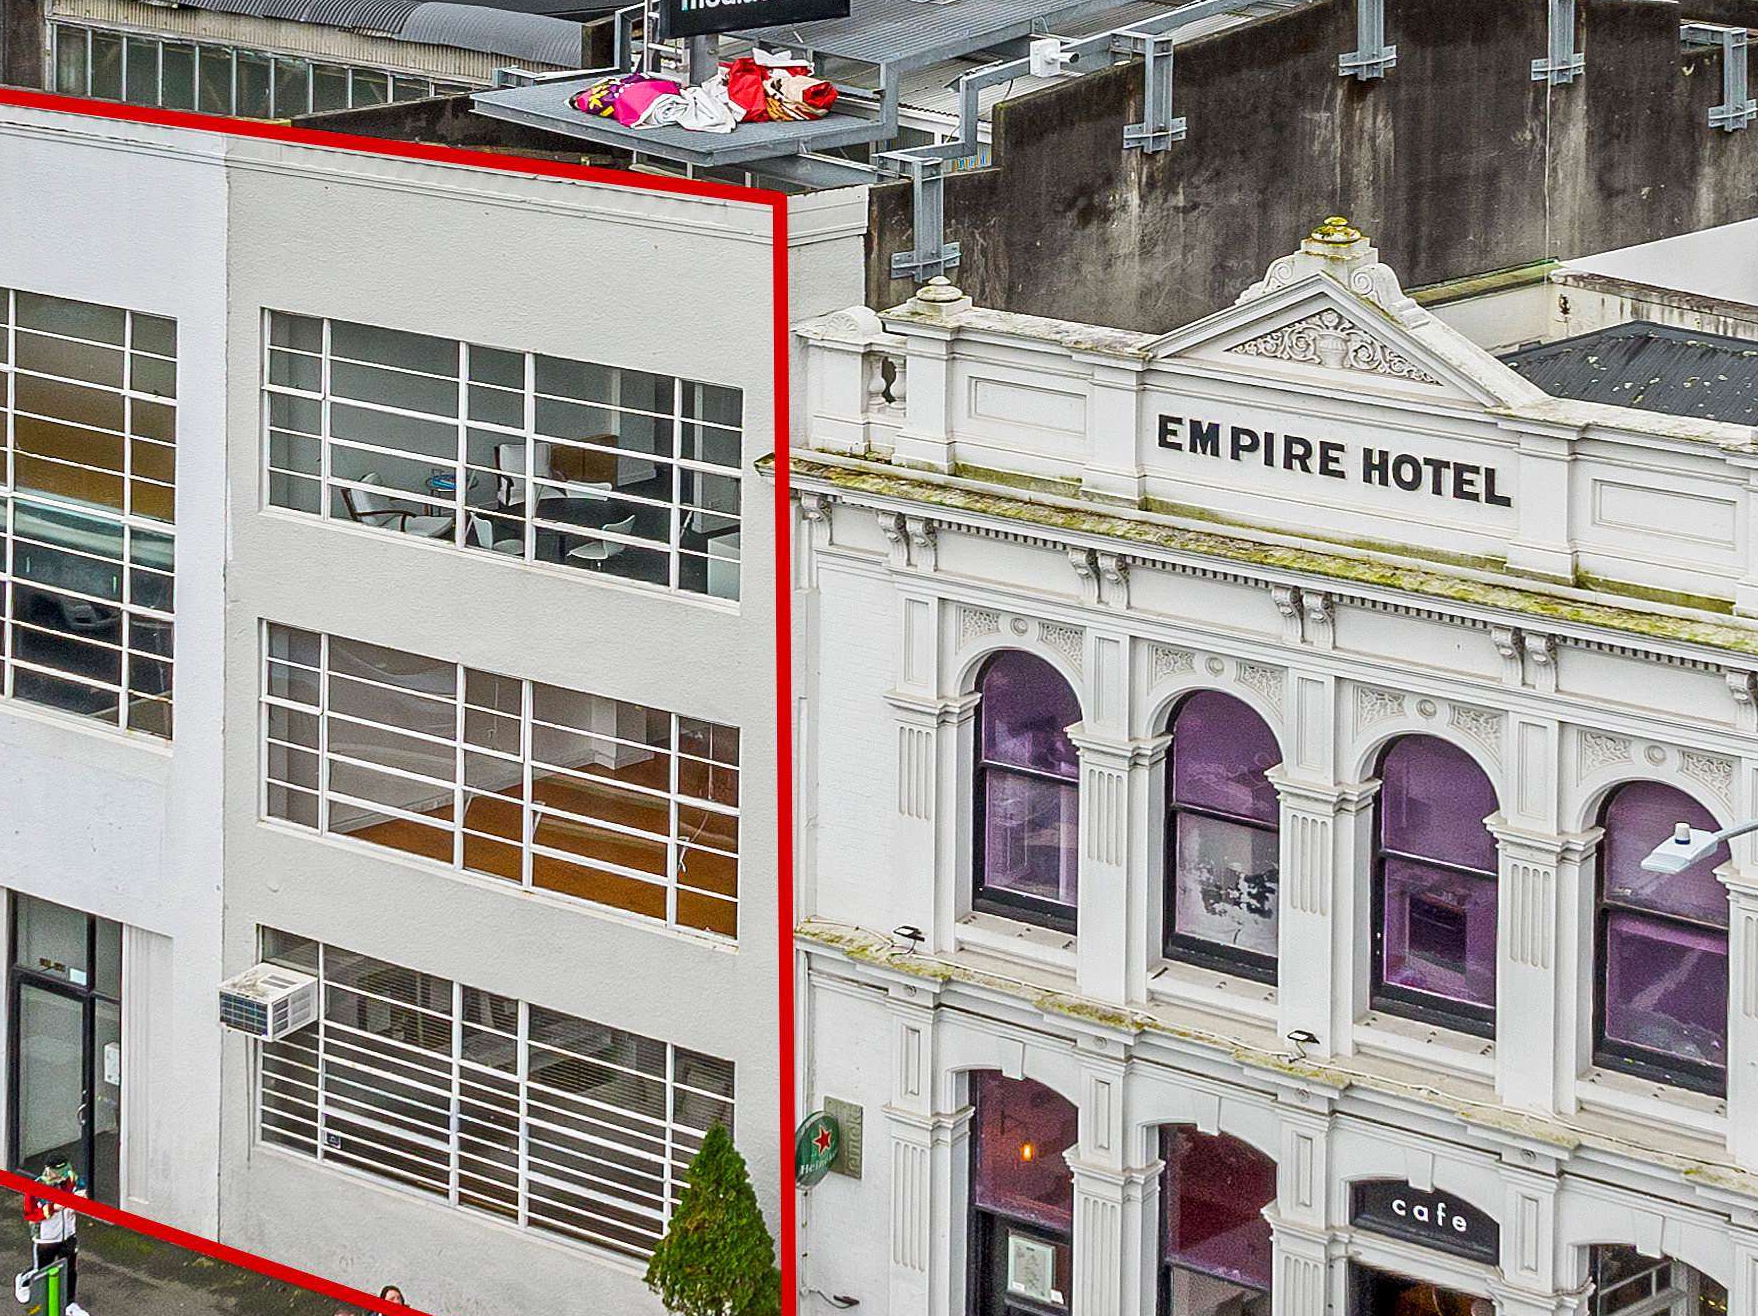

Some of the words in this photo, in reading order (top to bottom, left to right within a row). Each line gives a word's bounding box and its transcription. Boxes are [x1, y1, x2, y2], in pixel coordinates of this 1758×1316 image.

[1157, 413, 1346, 480] EMPIRE
[1362, 446, 1513, 507] HOTEL
[1392, 1199, 1467, 1232] cafe
